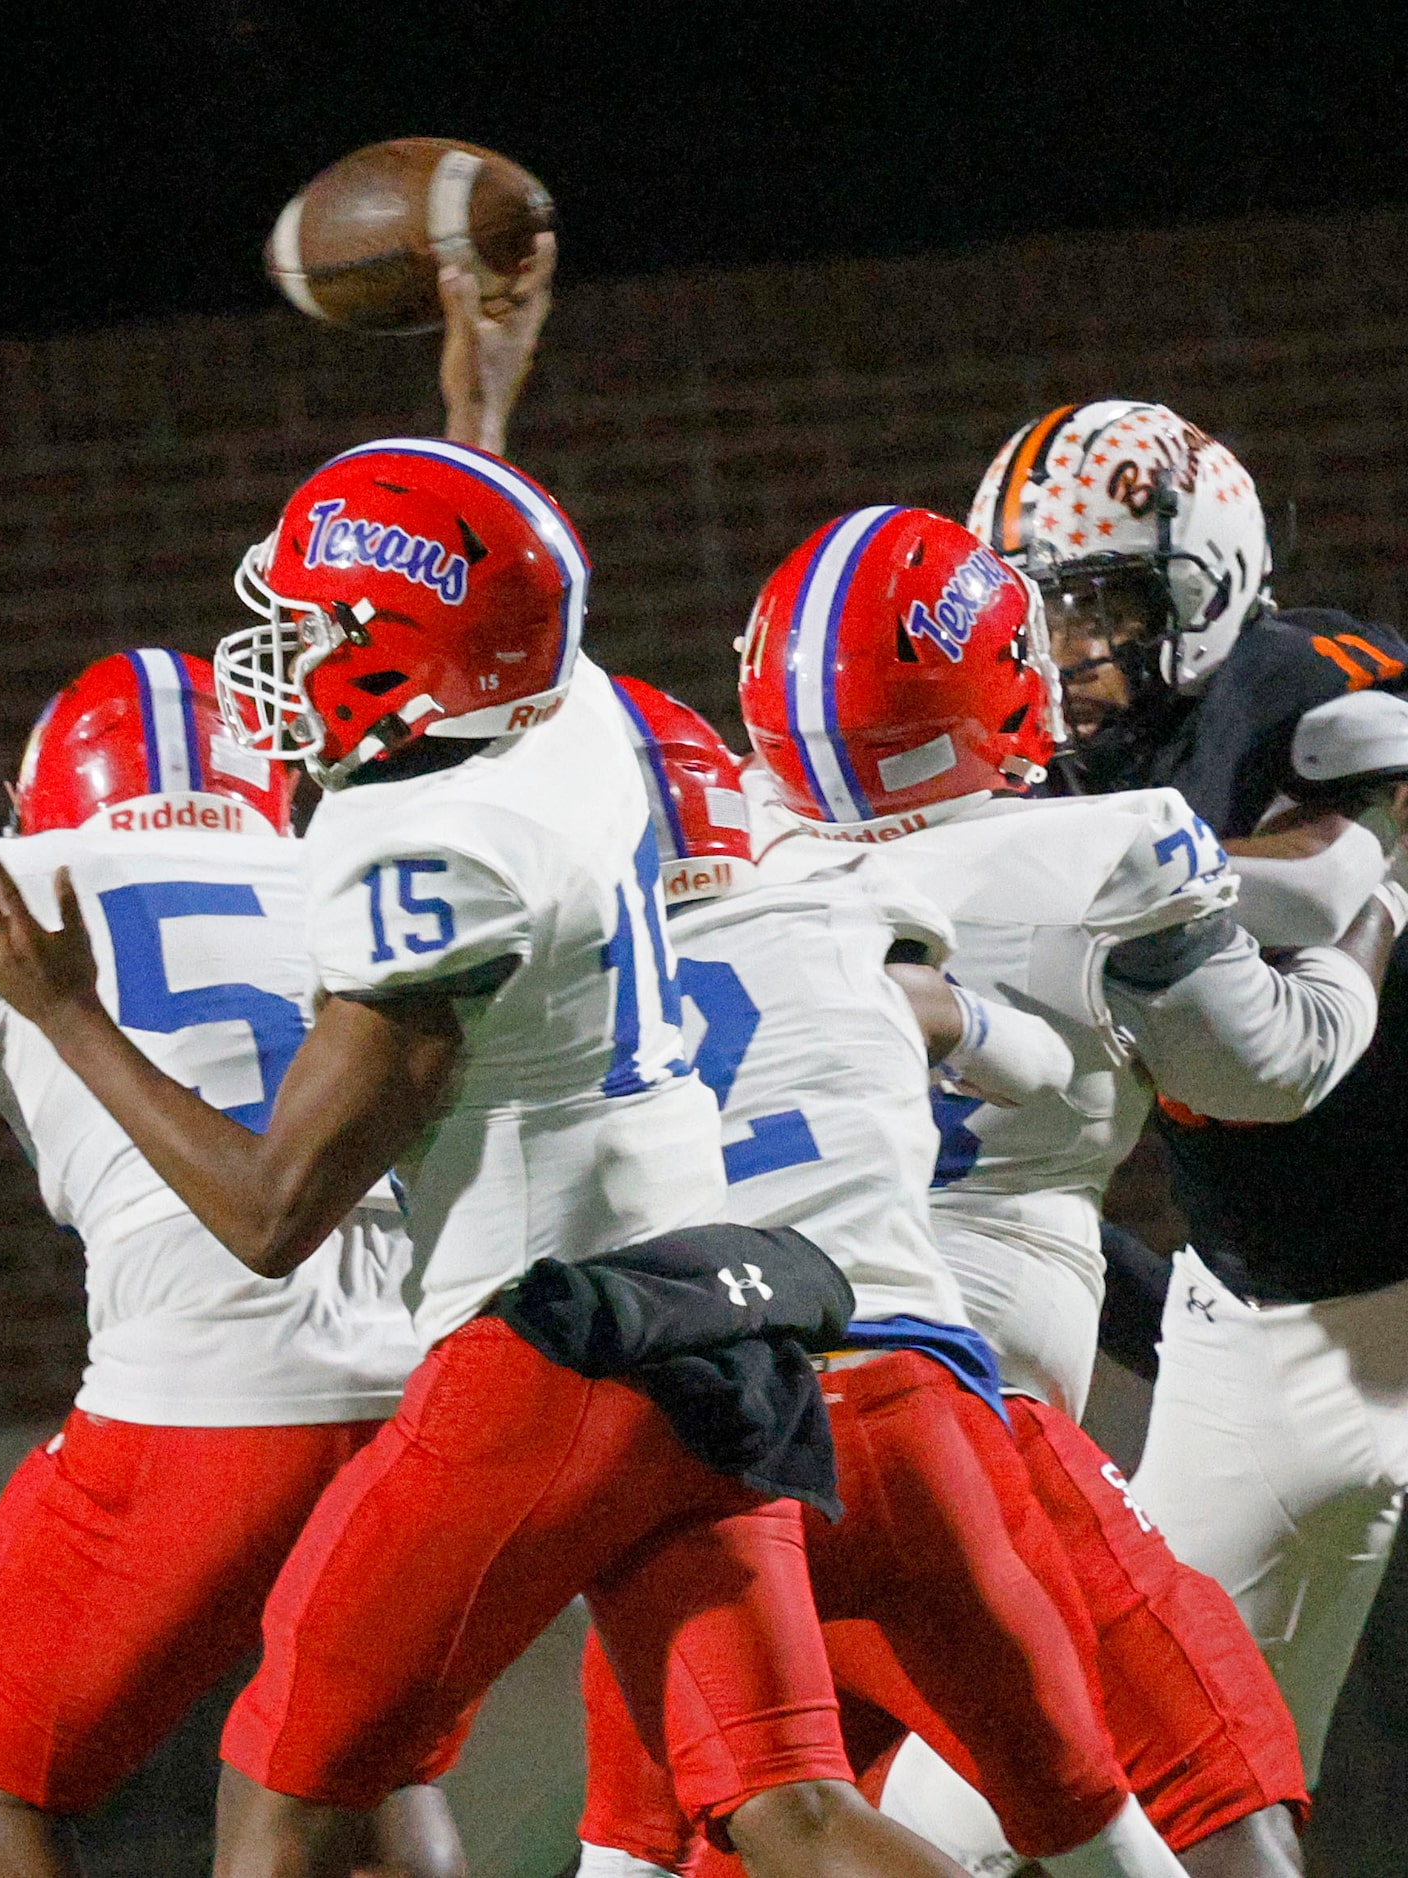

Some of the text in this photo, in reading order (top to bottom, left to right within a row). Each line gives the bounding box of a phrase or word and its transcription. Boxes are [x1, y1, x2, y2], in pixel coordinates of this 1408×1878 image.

[304, 498, 469, 605] Texans
[479, 673, 500, 691] 15
[110, 801, 243, 833] Riddell
[360, 859, 458, 964] 15
